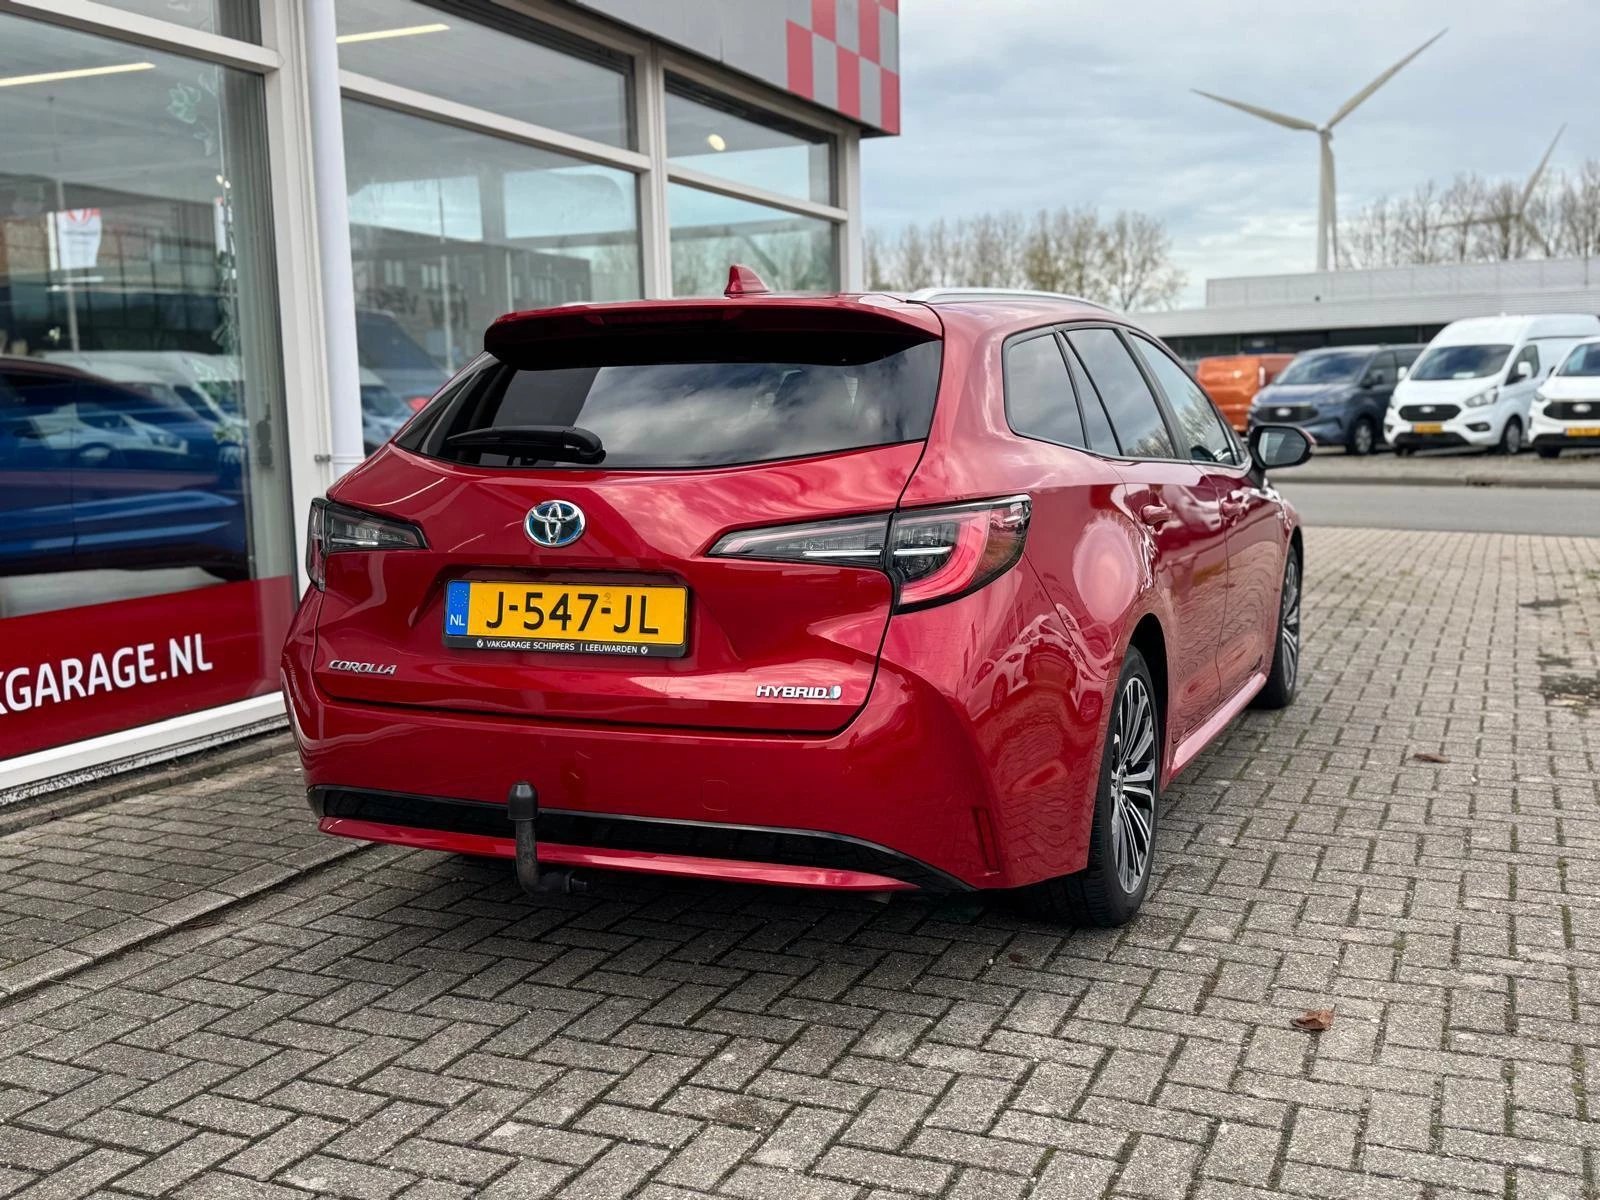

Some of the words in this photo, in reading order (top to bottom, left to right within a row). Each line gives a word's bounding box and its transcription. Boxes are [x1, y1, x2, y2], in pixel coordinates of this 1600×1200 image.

[486, 591, 659, 634] J-547-JL
[449, 614, 466, 627] NL
[486, 640, 532, 651] VAKGARAGE
[533, 642, 576, 652] SCHIPPERS
[585, 645, 639, 655] LEEUWARDEN
[0, 633, 213, 715] GARAGE.NL
[328, 659, 397, 675] COROLLA
[756, 685, 828, 699] HYBRID
